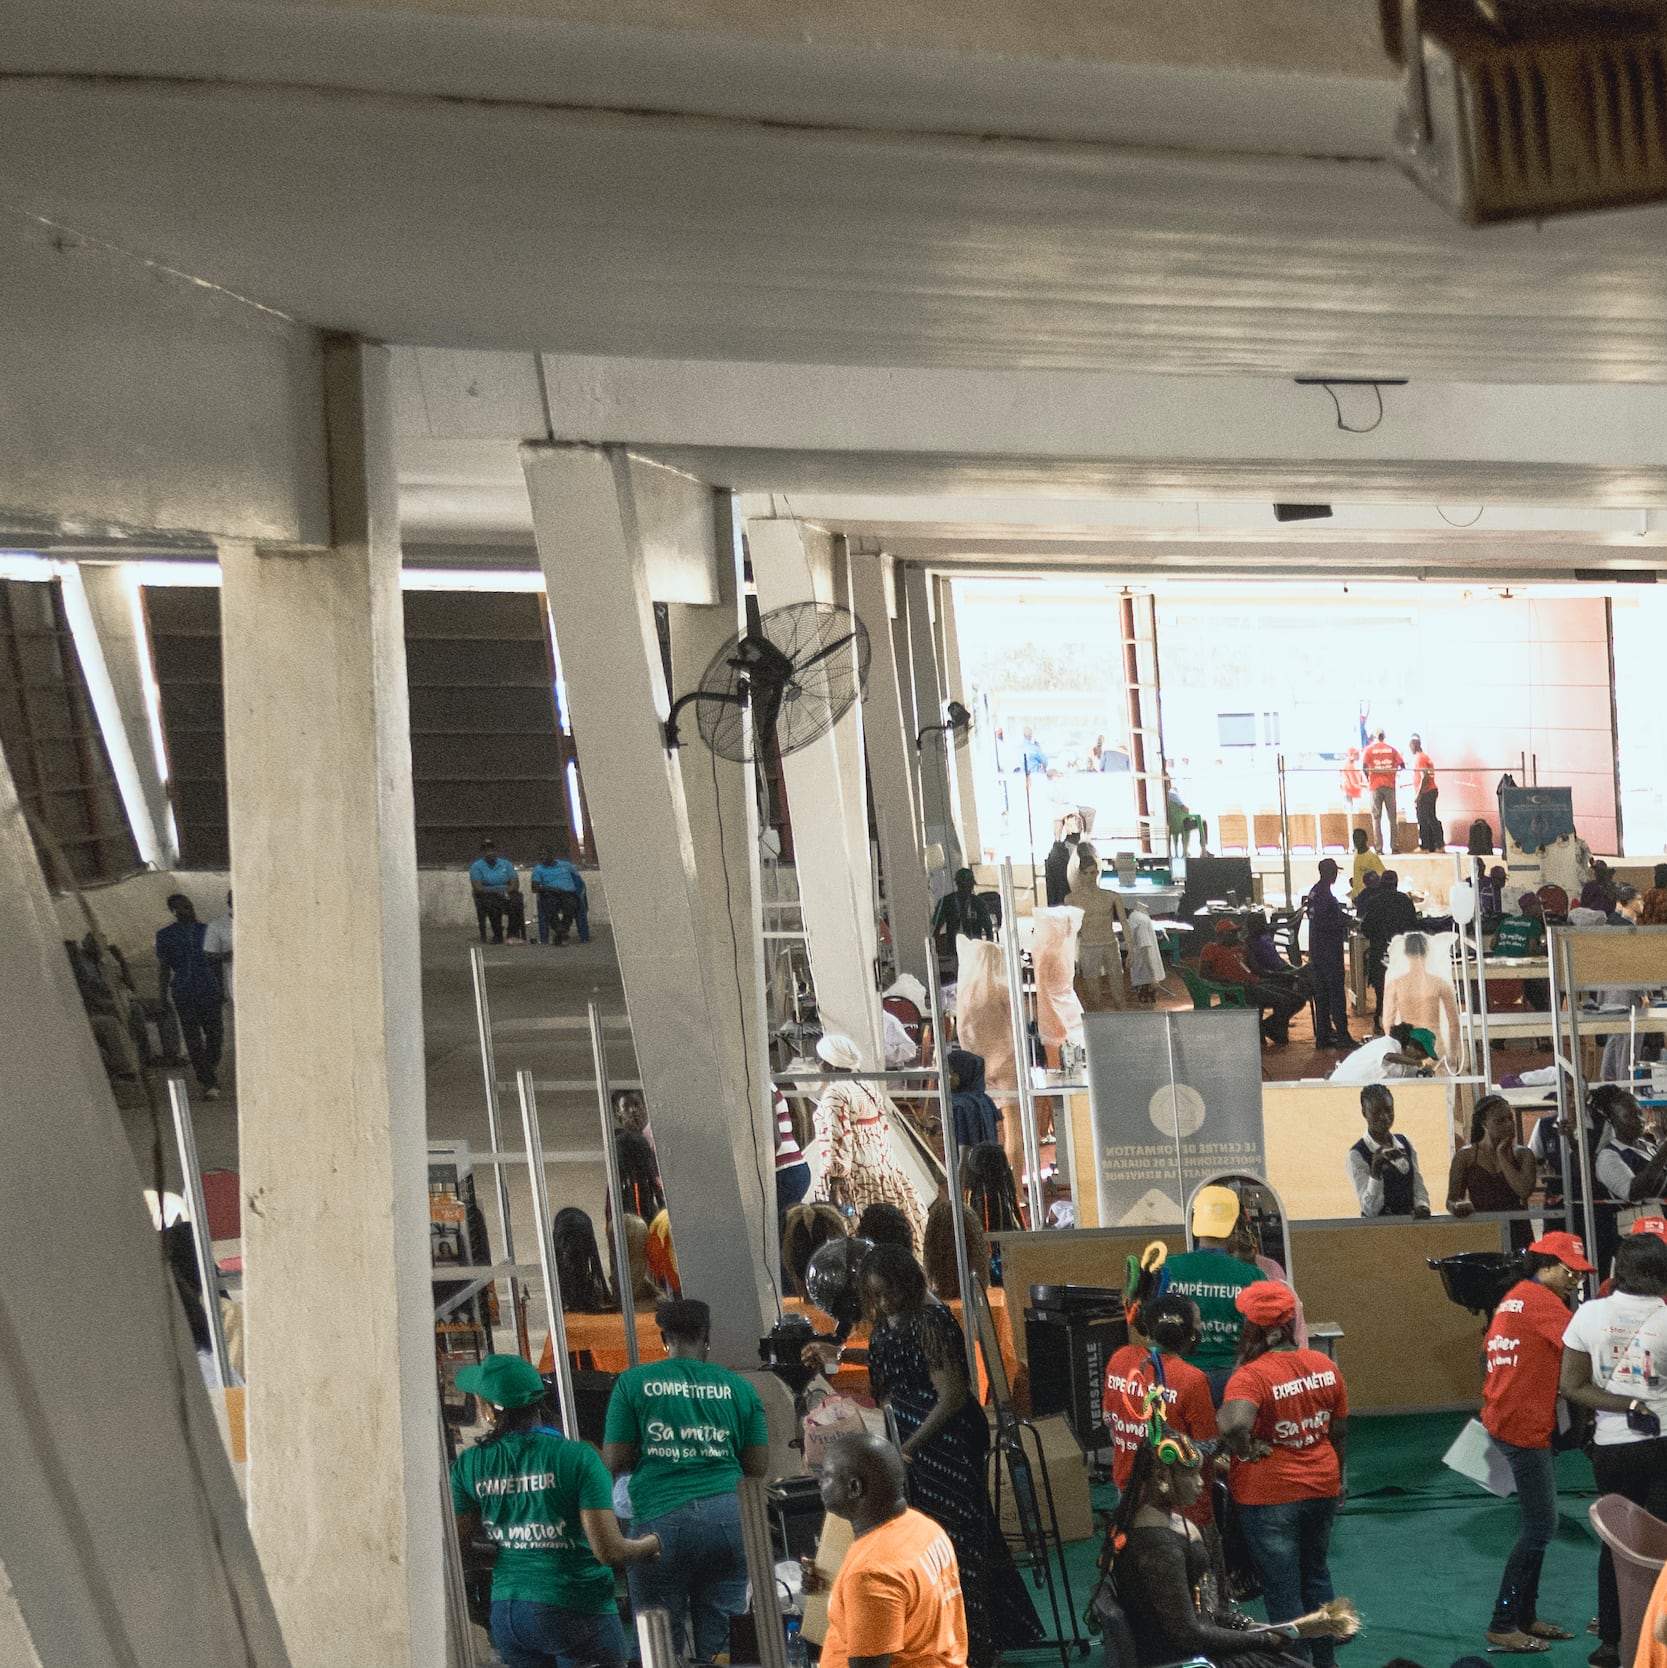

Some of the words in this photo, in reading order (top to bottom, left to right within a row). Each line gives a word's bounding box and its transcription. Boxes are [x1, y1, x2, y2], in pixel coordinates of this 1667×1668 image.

[1086, 1342, 1102, 1431] VERSATILE
[646, 1422, 674, 1442] Sa
[1275, 1419, 1301, 1440] Sa
[646, 1447, 680, 1463] mooy
